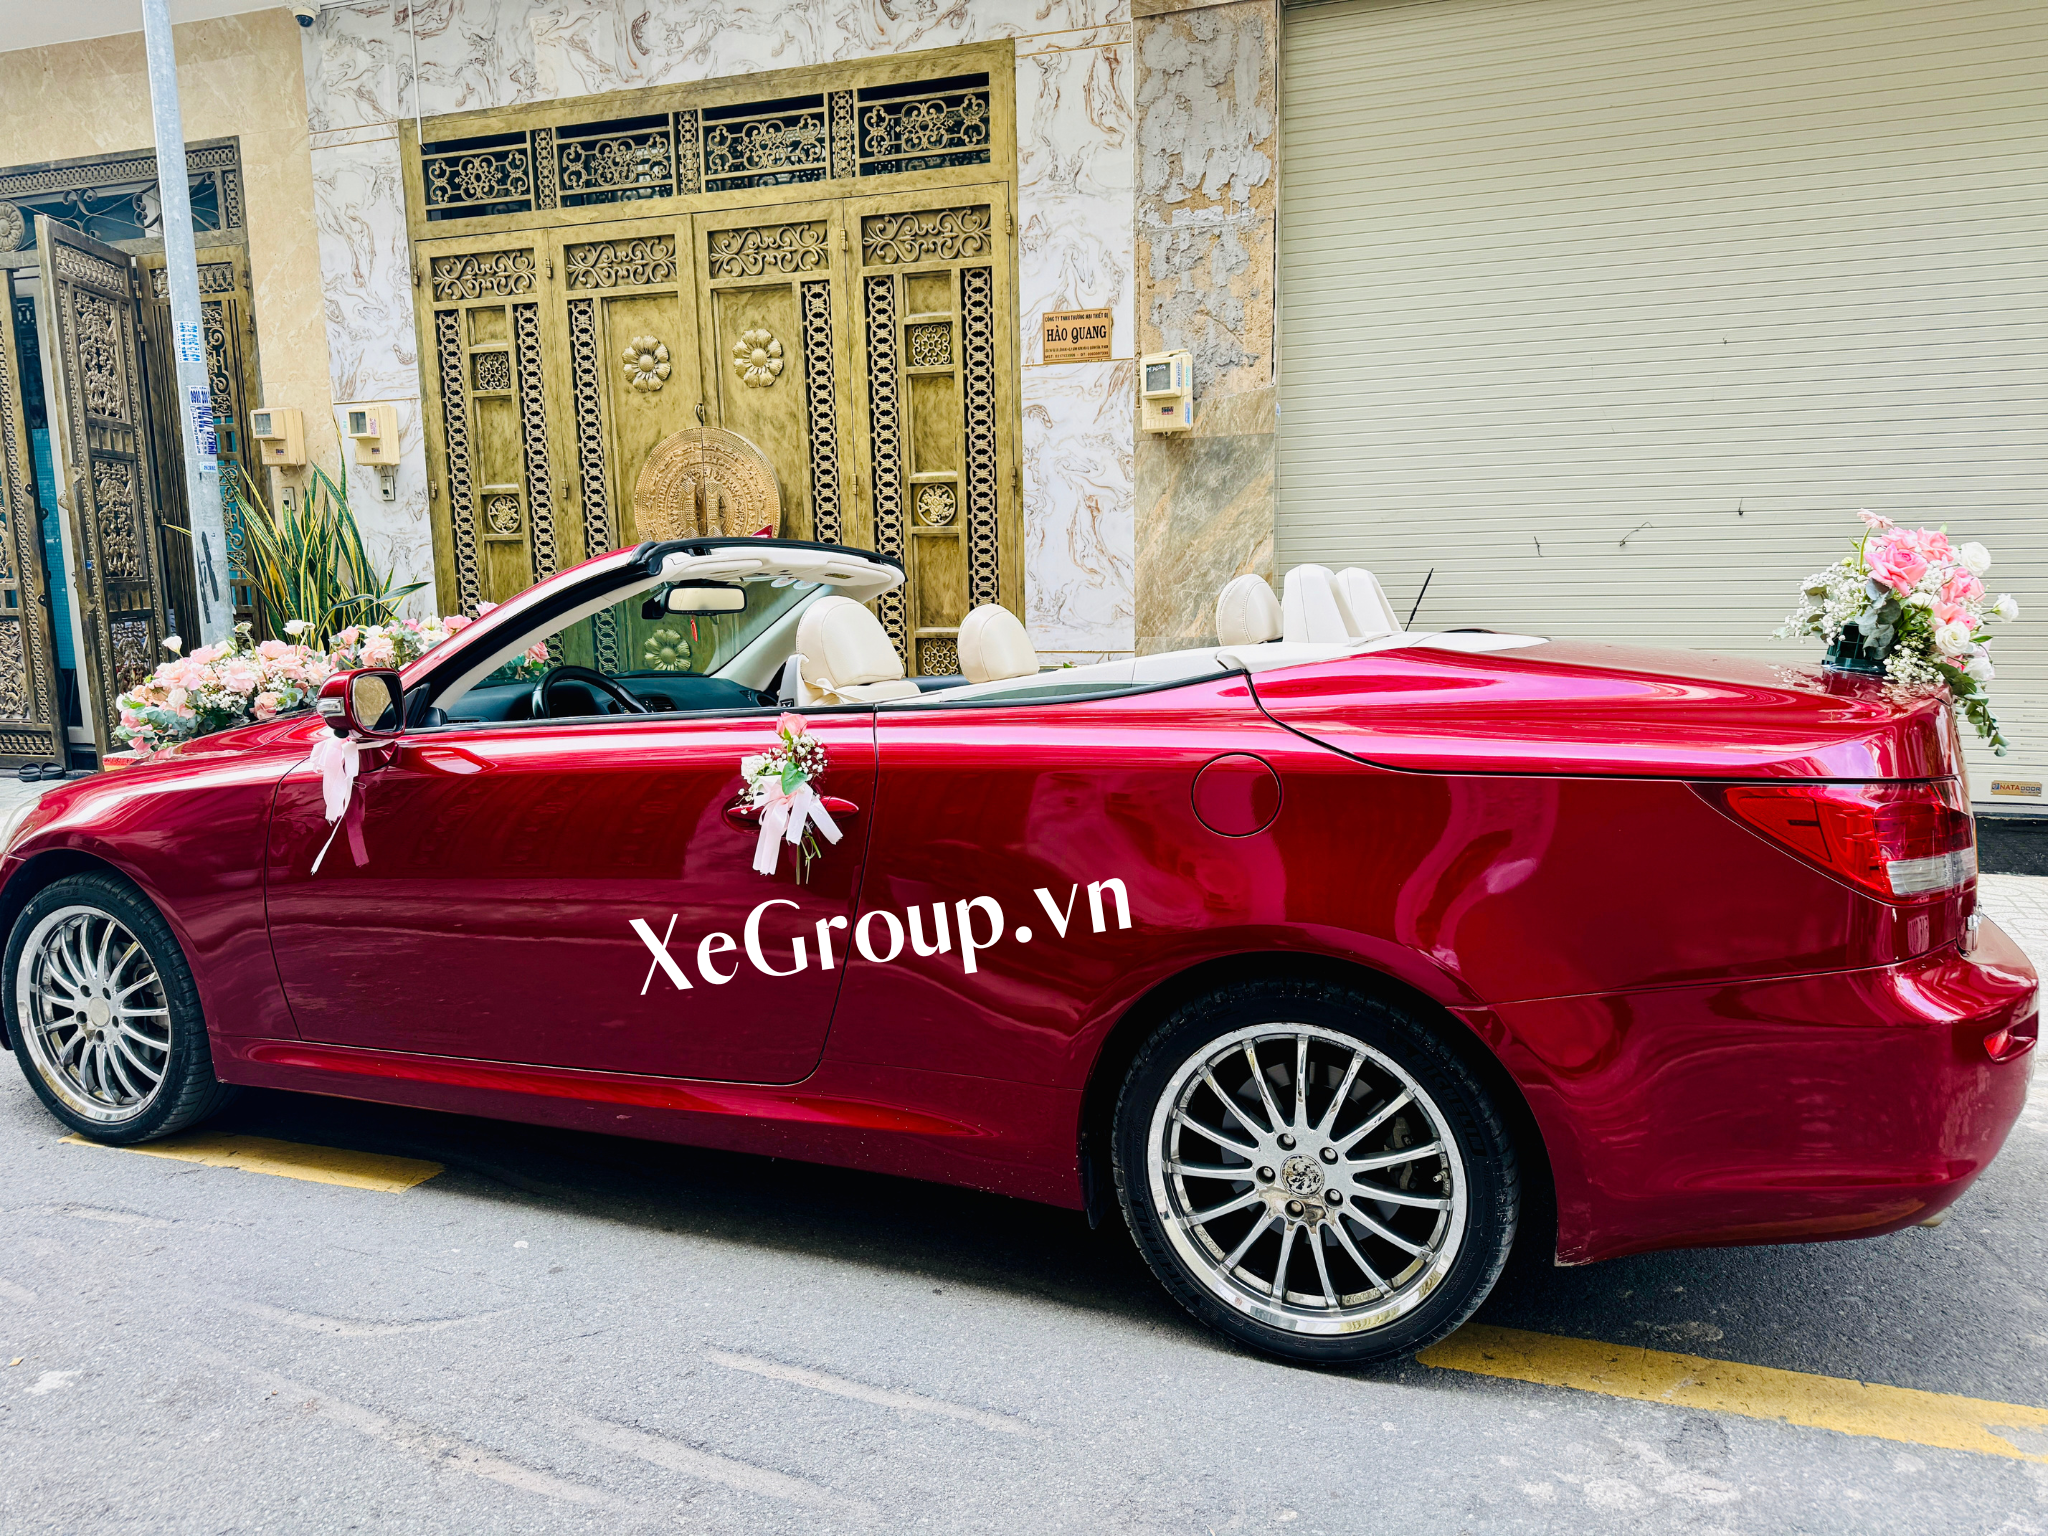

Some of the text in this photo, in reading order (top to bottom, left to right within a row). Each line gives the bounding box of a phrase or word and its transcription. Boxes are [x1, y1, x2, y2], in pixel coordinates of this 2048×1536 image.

[1047, 325, 1106, 343] HÀO QUANG
[1411, 1053, 1487, 1156] MICHELIN
